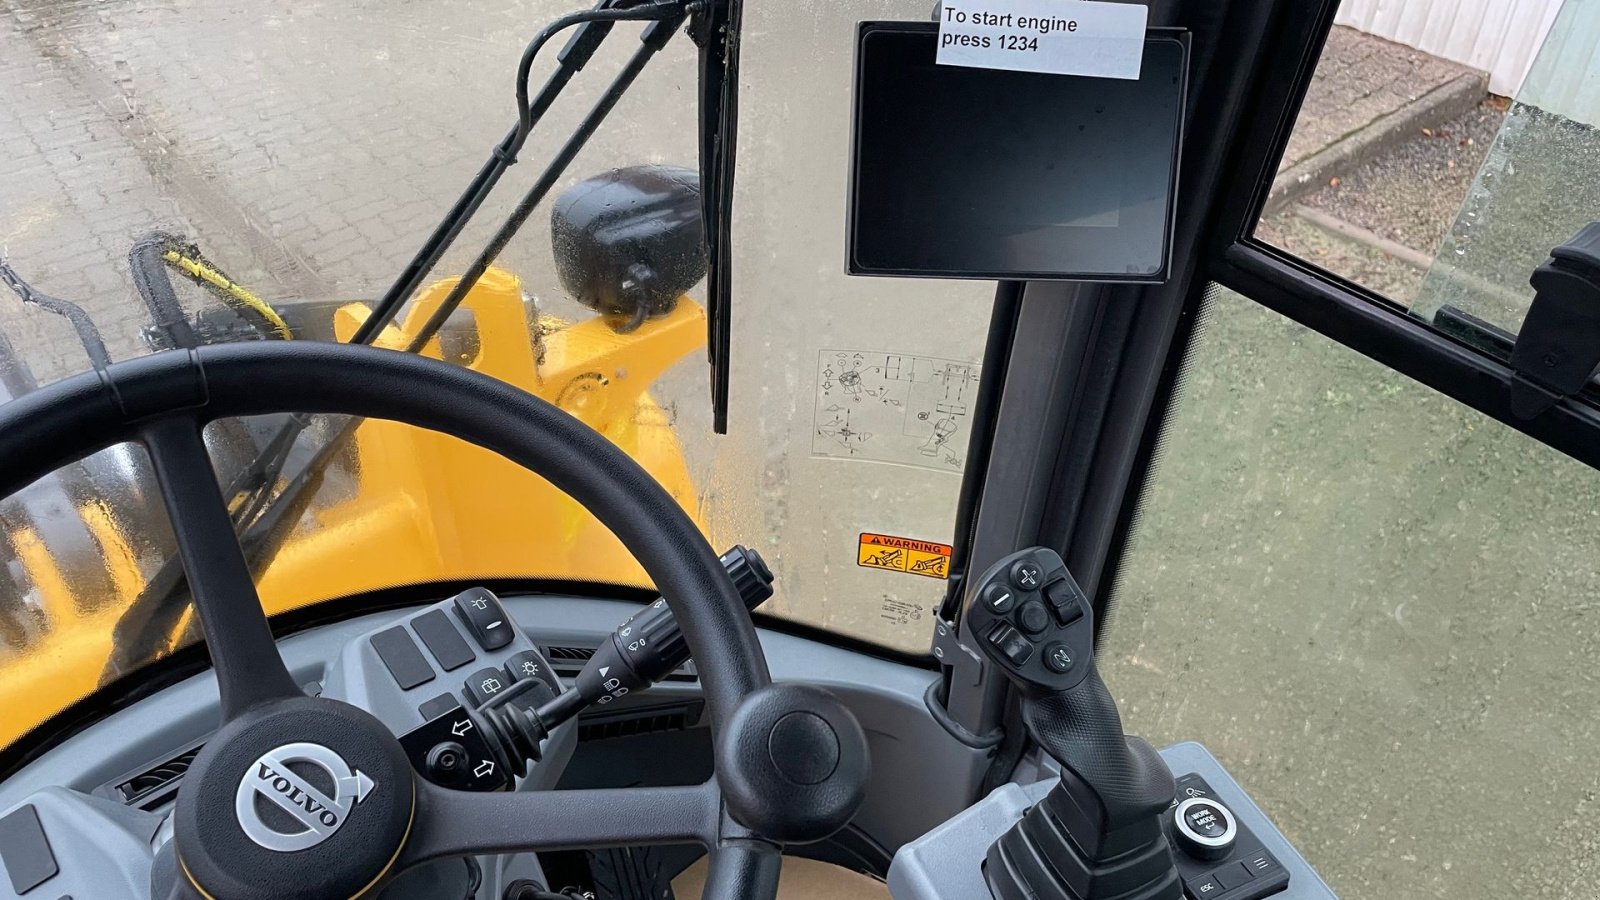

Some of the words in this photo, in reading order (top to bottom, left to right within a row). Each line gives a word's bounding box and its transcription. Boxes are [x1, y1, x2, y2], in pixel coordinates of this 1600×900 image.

[945, 7, 967, 23] To
[972, 11, 1012, 28] start
[1017, 15, 1078, 34] engine
[942, 32, 991, 48] press
[998, 34, 1039, 52] 1234
[883, 537, 941, 554] WARNING
[257, 762, 338, 828] VOLVO
[1191, 808, 1212, 820] WORK
[1196, 815, 1217, 826] MODE
[1200, 883, 1215, 893] ESC
